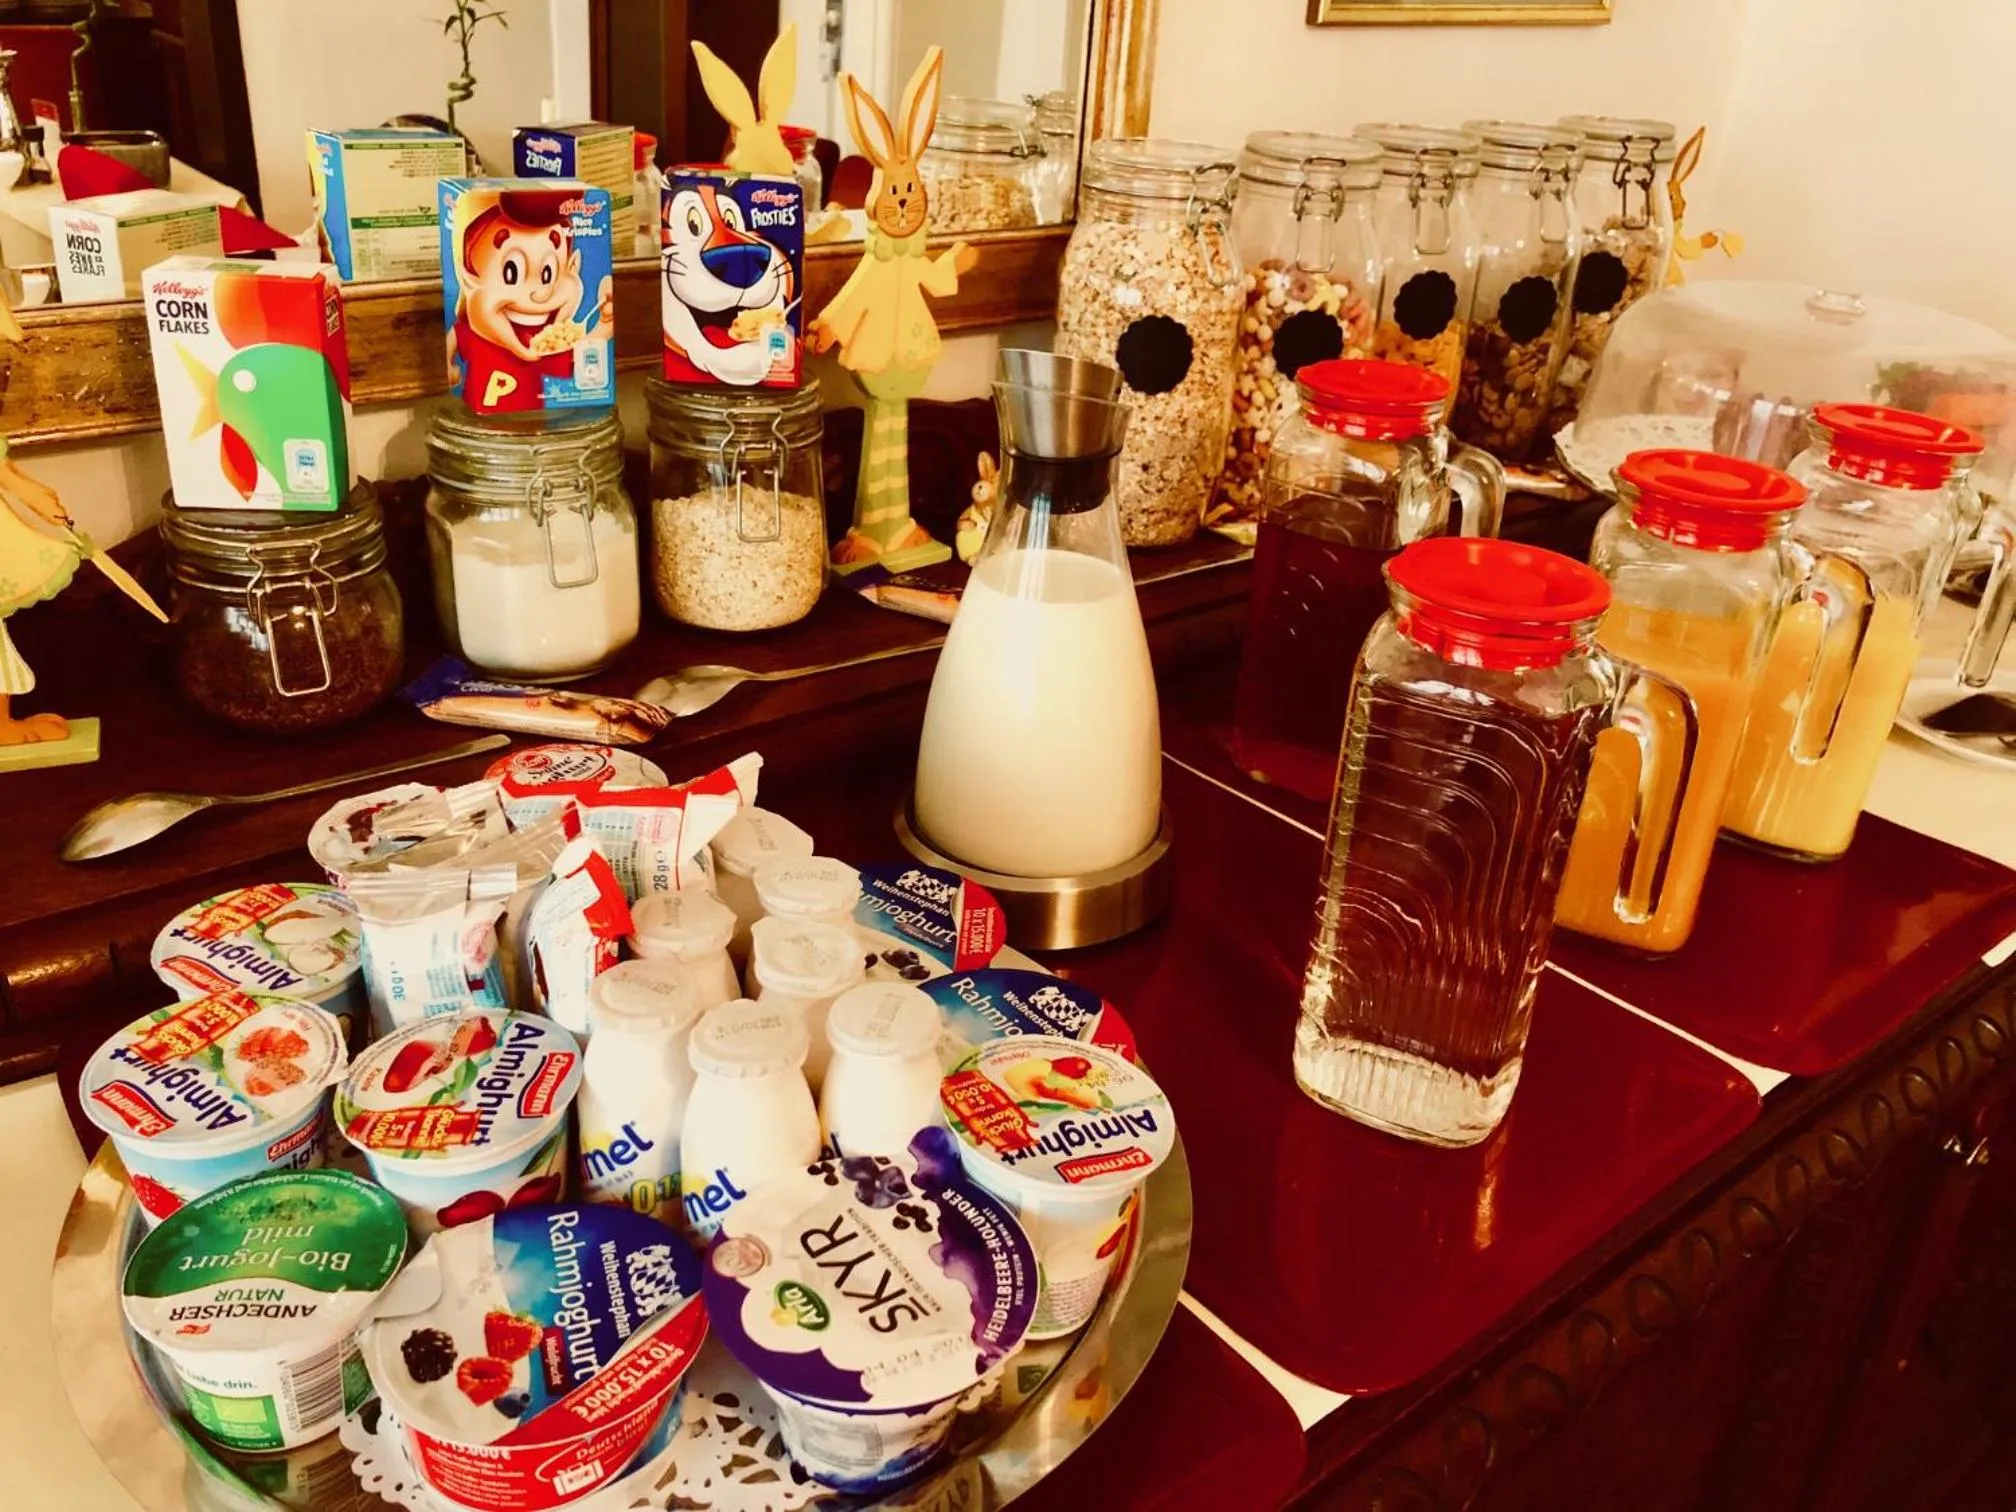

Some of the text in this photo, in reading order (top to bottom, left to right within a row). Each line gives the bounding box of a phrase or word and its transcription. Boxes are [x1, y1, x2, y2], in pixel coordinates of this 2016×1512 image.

[750, 204, 799, 229] FROSTIES
[152, 281, 205, 299] Kellogg's
[155, 299, 209, 319] CORN
[158, 319, 210, 335] FLAKES
[653, 874, 668, 892] 28
[872, 879, 950, 917] Weihenstephan
[861, 893, 958, 942] mjoghurt
[170, 928, 303, 990] Almighurt
[950, 977, 1024, 1037] Rahmjo
[109, 1047, 248, 1130] Almighurt
[472, 1022, 546, 1146] Almighurt
[531, 1055, 569, 1114] Ehrmann
[102, 1087, 167, 1136] Ehrmann
[1001, 1109, 1158, 1166] Almighurt
[1065, 1148, 1146, 1178] Ehrmann
[242, 1224, 315, 1246] mild
[178, 1247, 352, 1273] Bio-Jogurt
[799, 1213, 930, 1334] SKYR
[940, 1187, 1014, 1342] HEIDELBEERE-HOLUNDER
[214, 1288, 284, 1302] NATUR
[547, 1210, 602, 1381] Rahmjoghurt
[599, 1240, 632, 1339] Weihenstephan
[783, 1285, 825, 1326] Arla
[168, 1303, 317, 1321] ANDECHSER
[639, 1356, 653, 1370] x
[649, 1340, 675, 1359] 10
